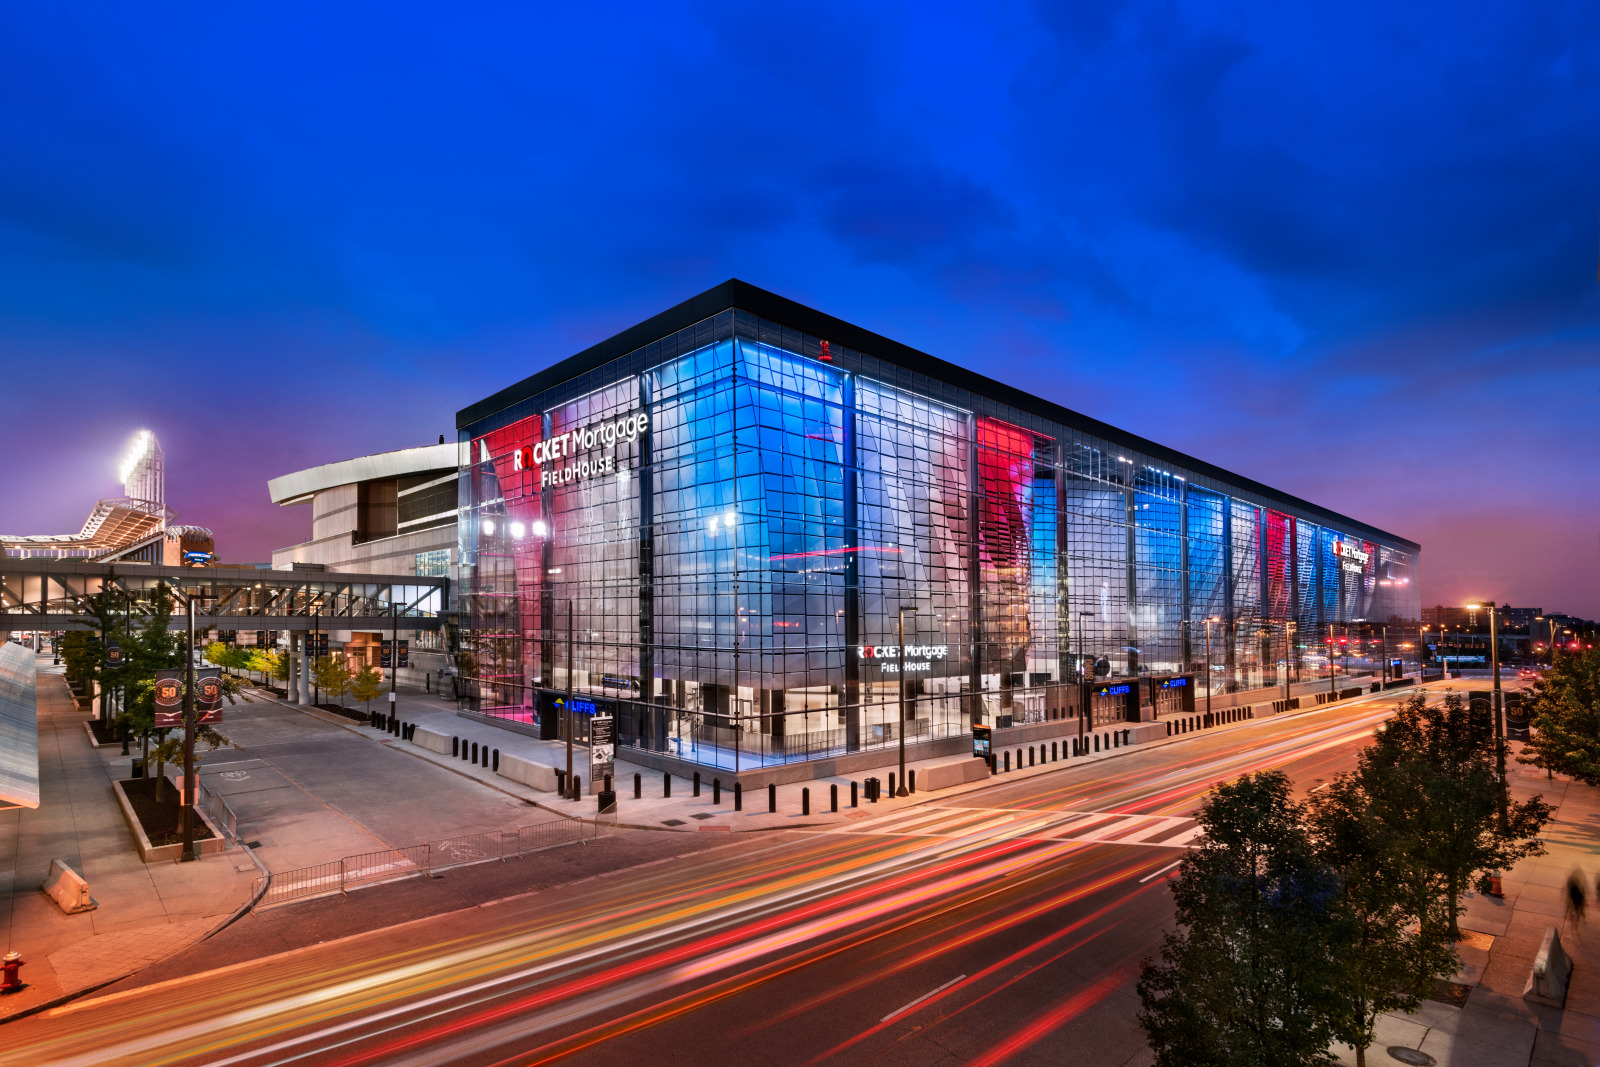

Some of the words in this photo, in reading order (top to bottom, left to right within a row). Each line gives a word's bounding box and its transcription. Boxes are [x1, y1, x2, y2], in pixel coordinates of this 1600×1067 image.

[514, 433, 570, 471] ROCKET
[572, 412, 649, 452] Mortgage
[110, 651, 120, 659] 50
[904, 645, 949, 659] Mortgage
[1169, 678, 1187, 689] CLIFFS
[161, 686, 177, 698] 50
[203, 684, 217, 696] 50
[1109, 685, 1130, 696] CLIFFS
[1510, 706, 1524, 717] 50
